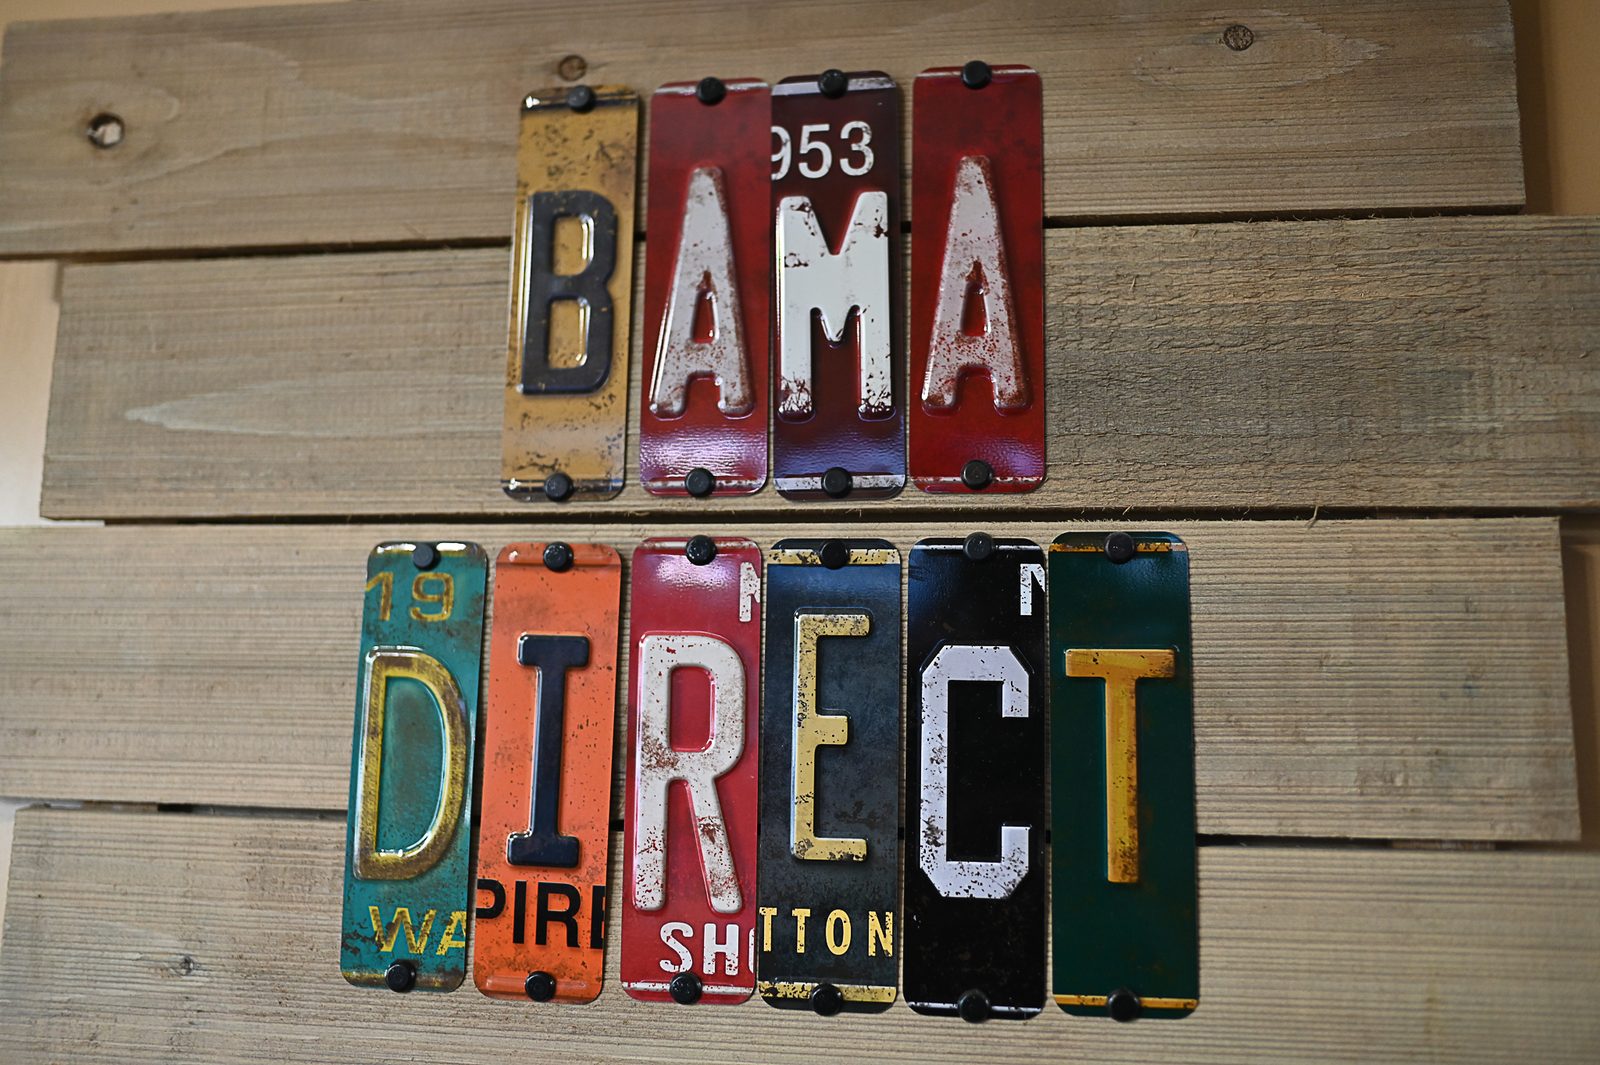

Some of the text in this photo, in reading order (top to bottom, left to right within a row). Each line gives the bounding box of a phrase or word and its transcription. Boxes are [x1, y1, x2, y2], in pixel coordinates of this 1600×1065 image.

[771, 121, 874, 180] 953
[519, 155, 1031, 417] BAMA
[365, 571, 454, 622] 19
[352, 610, 1177, 913] DIRECT
[659, 921, 755, 975] SH
[759, 907, 893, 957] TTON
